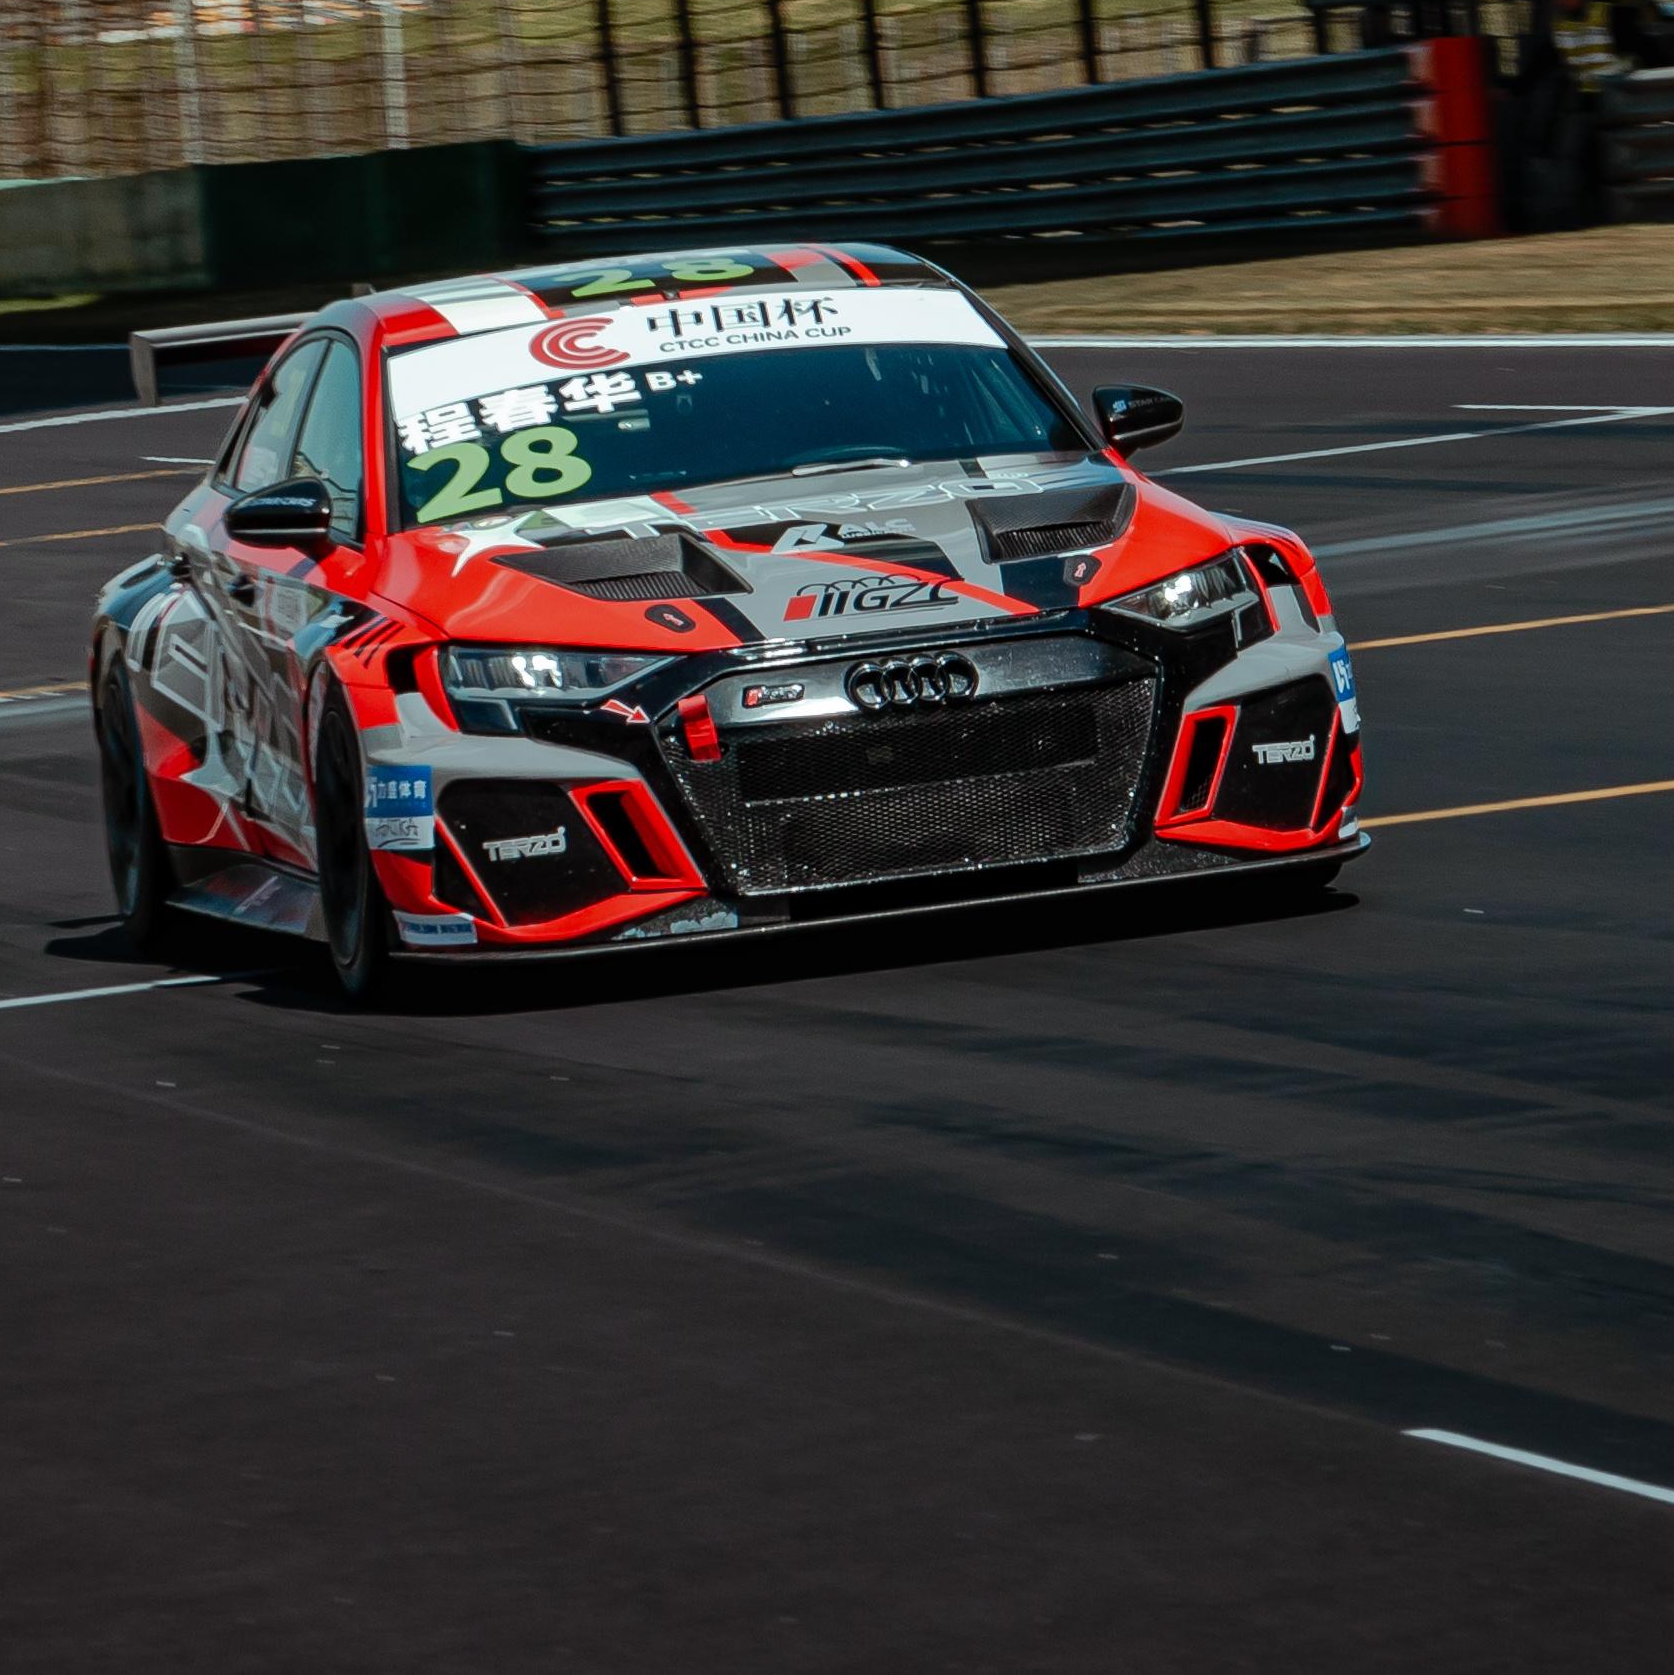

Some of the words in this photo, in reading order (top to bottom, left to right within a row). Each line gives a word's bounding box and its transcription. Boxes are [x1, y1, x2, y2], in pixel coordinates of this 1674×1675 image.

[551, 258, 755, 298] 28
[646, 297, 839, 338] 中国杯
[659, 336, 720, 353] CTCC
[726, 328, 799, 345] CHINA
[805, 325, 852, 339] CUP
[397, 370, 643, 456] 程春华
[645, 369, 704, 392] B+
[406, 425, 593, 524] 28
[1252, 735, 1316, 764] TERZO
[482, 828, 567, 862] TERZO
